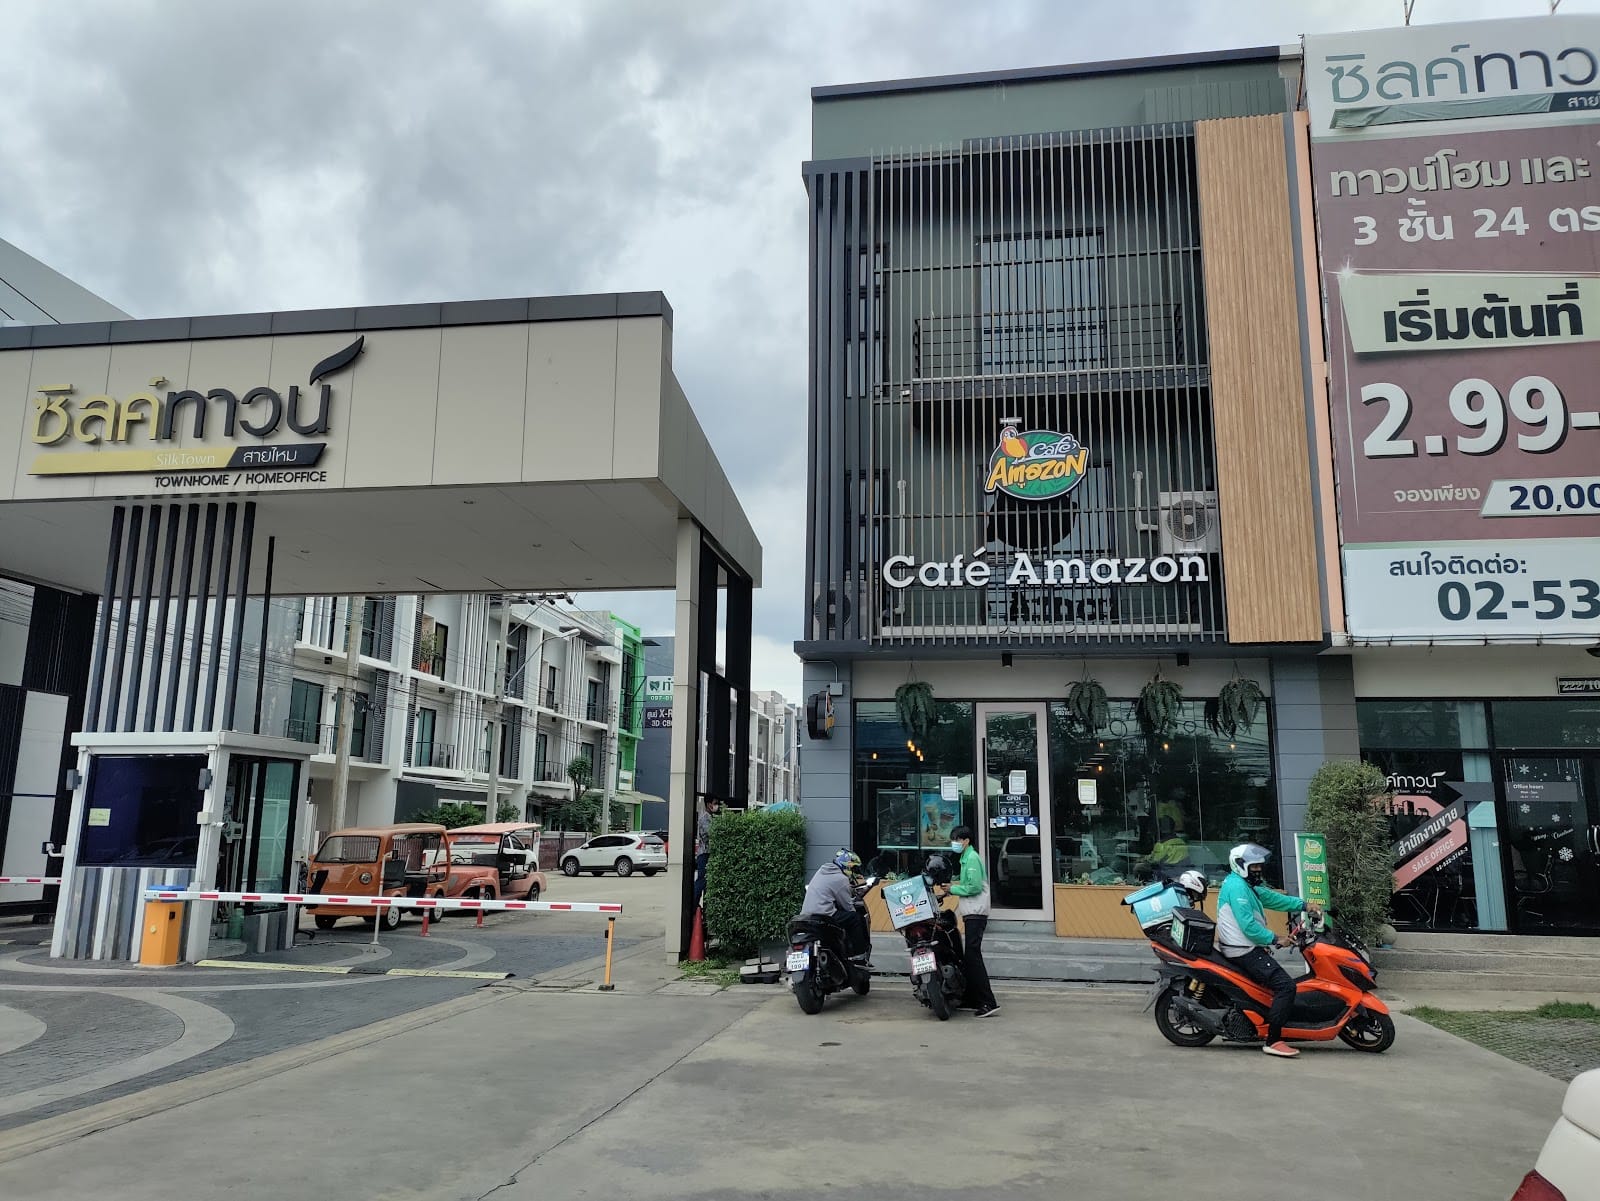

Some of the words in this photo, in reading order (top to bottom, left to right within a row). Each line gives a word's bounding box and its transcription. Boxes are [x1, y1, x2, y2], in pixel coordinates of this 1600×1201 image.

[1330, 149, 1510, 196] ทาวน์โฮม
[1520, 156, 1591, 184] และ
[1353, 215, 1378, 246] 3
[1398, 198, 1454, 243] ชั้น
[1473, 206, 1529, 239] 24
[1383, 282, 1584, 343] เริ่มต้นที่
[243, 447, 297, 463] สายไหม
[155, 474, 230, 487] TOWNHOME
[233, 474, 242, 485] /
[245, 471, 327, 484] HOMEOFFICE
[1393, 484, 1480, 502] จองเพียง
[883, 546, 991, 588] Café
[1005, 551, 1209, 586] Amazon
[1389, 551, 1527, 576] สนใจติดต่อ:
[1437, 579, 1600, 621] 02-53
[1386, 771, 1446, 788] ค์ทาวน์
[1398, 807, 1459, 856] สำนักงานขาย
[1411, 856, 1431, 873] SALE
[1430, 838, 1456, 861] OFFICE
